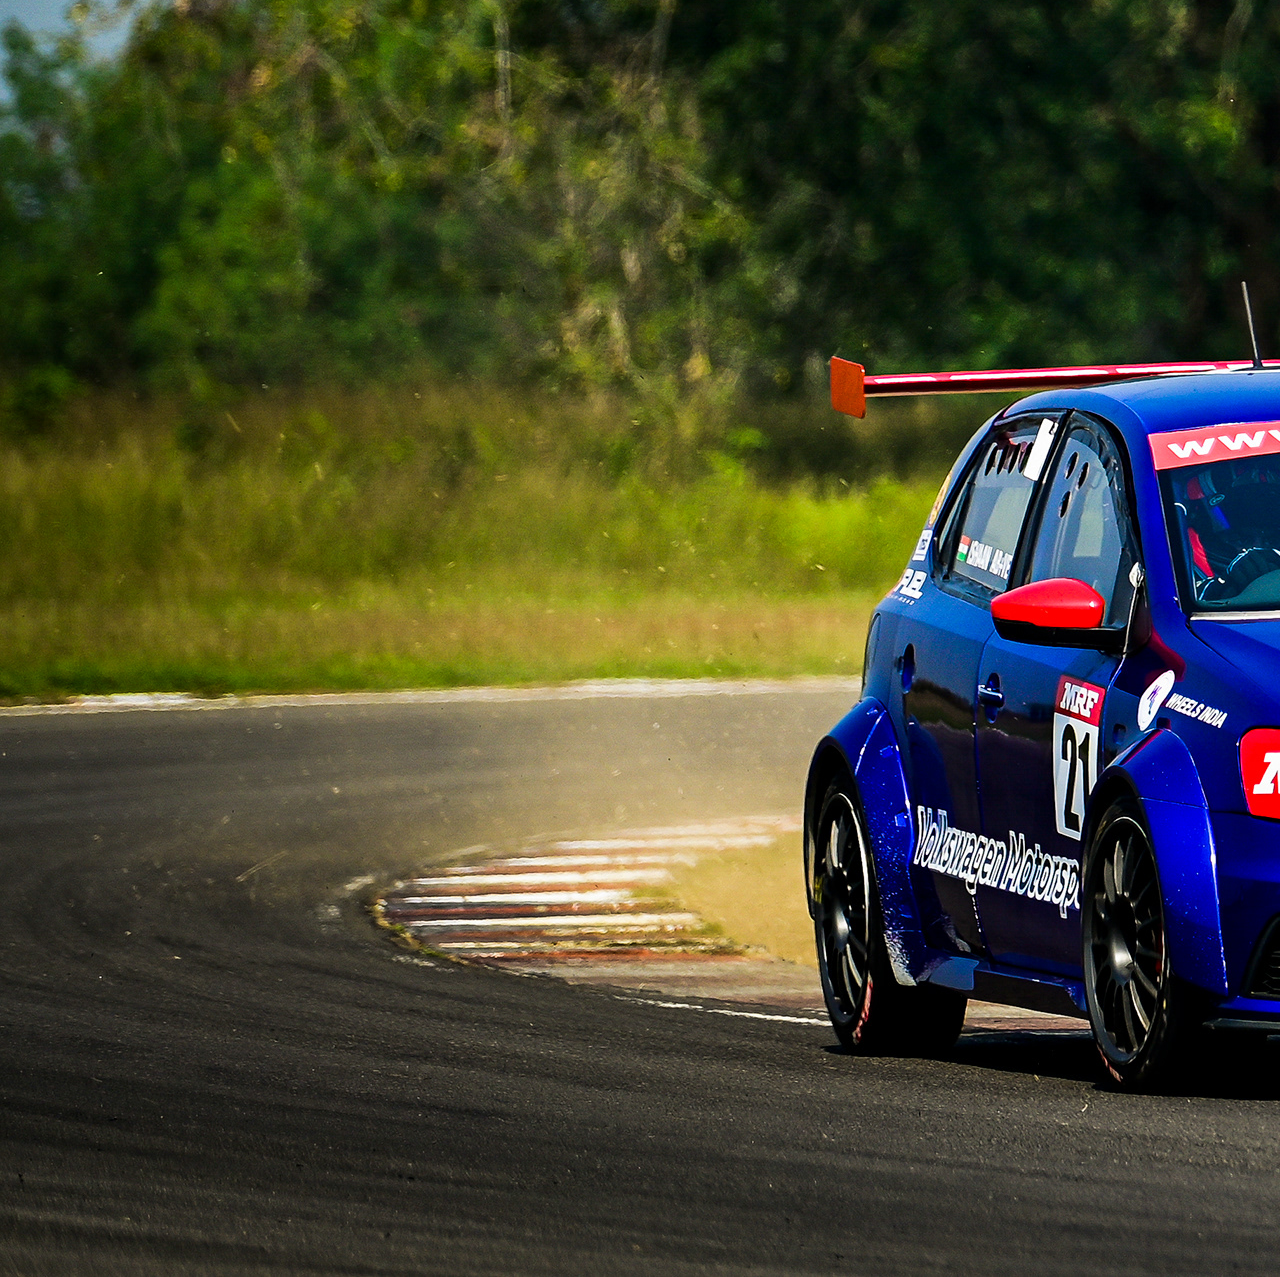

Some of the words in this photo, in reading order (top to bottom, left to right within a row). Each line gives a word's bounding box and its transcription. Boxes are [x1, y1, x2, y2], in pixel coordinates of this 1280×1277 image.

[1060, 682, 1099, 718] MRF
[1165, 692, 1206, 718] WHEELS
[1197, 705, 1228, 729] INDIA
[1062, 723, 1091, 832] 21
[913, 805, 1007, 895] Volkswagen
[1000, 829, 1081, 919] Motorsp
